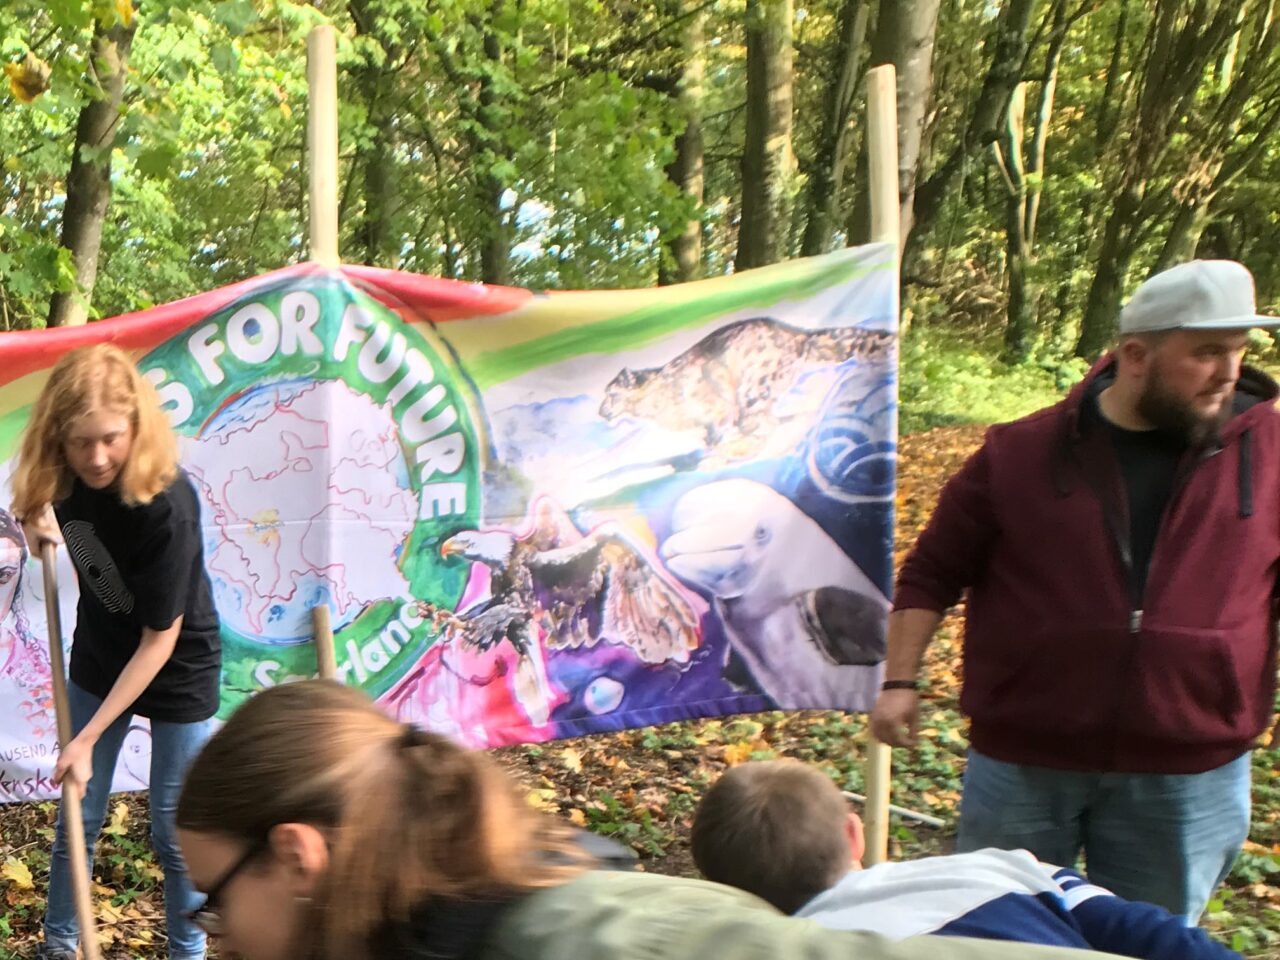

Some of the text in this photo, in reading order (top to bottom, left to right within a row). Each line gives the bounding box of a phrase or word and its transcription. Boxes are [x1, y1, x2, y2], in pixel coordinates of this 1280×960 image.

[188, 291, 324, 385] FOR
[333, 303, 467, 521] FUTURE
[51, 740, 61, 755] A
